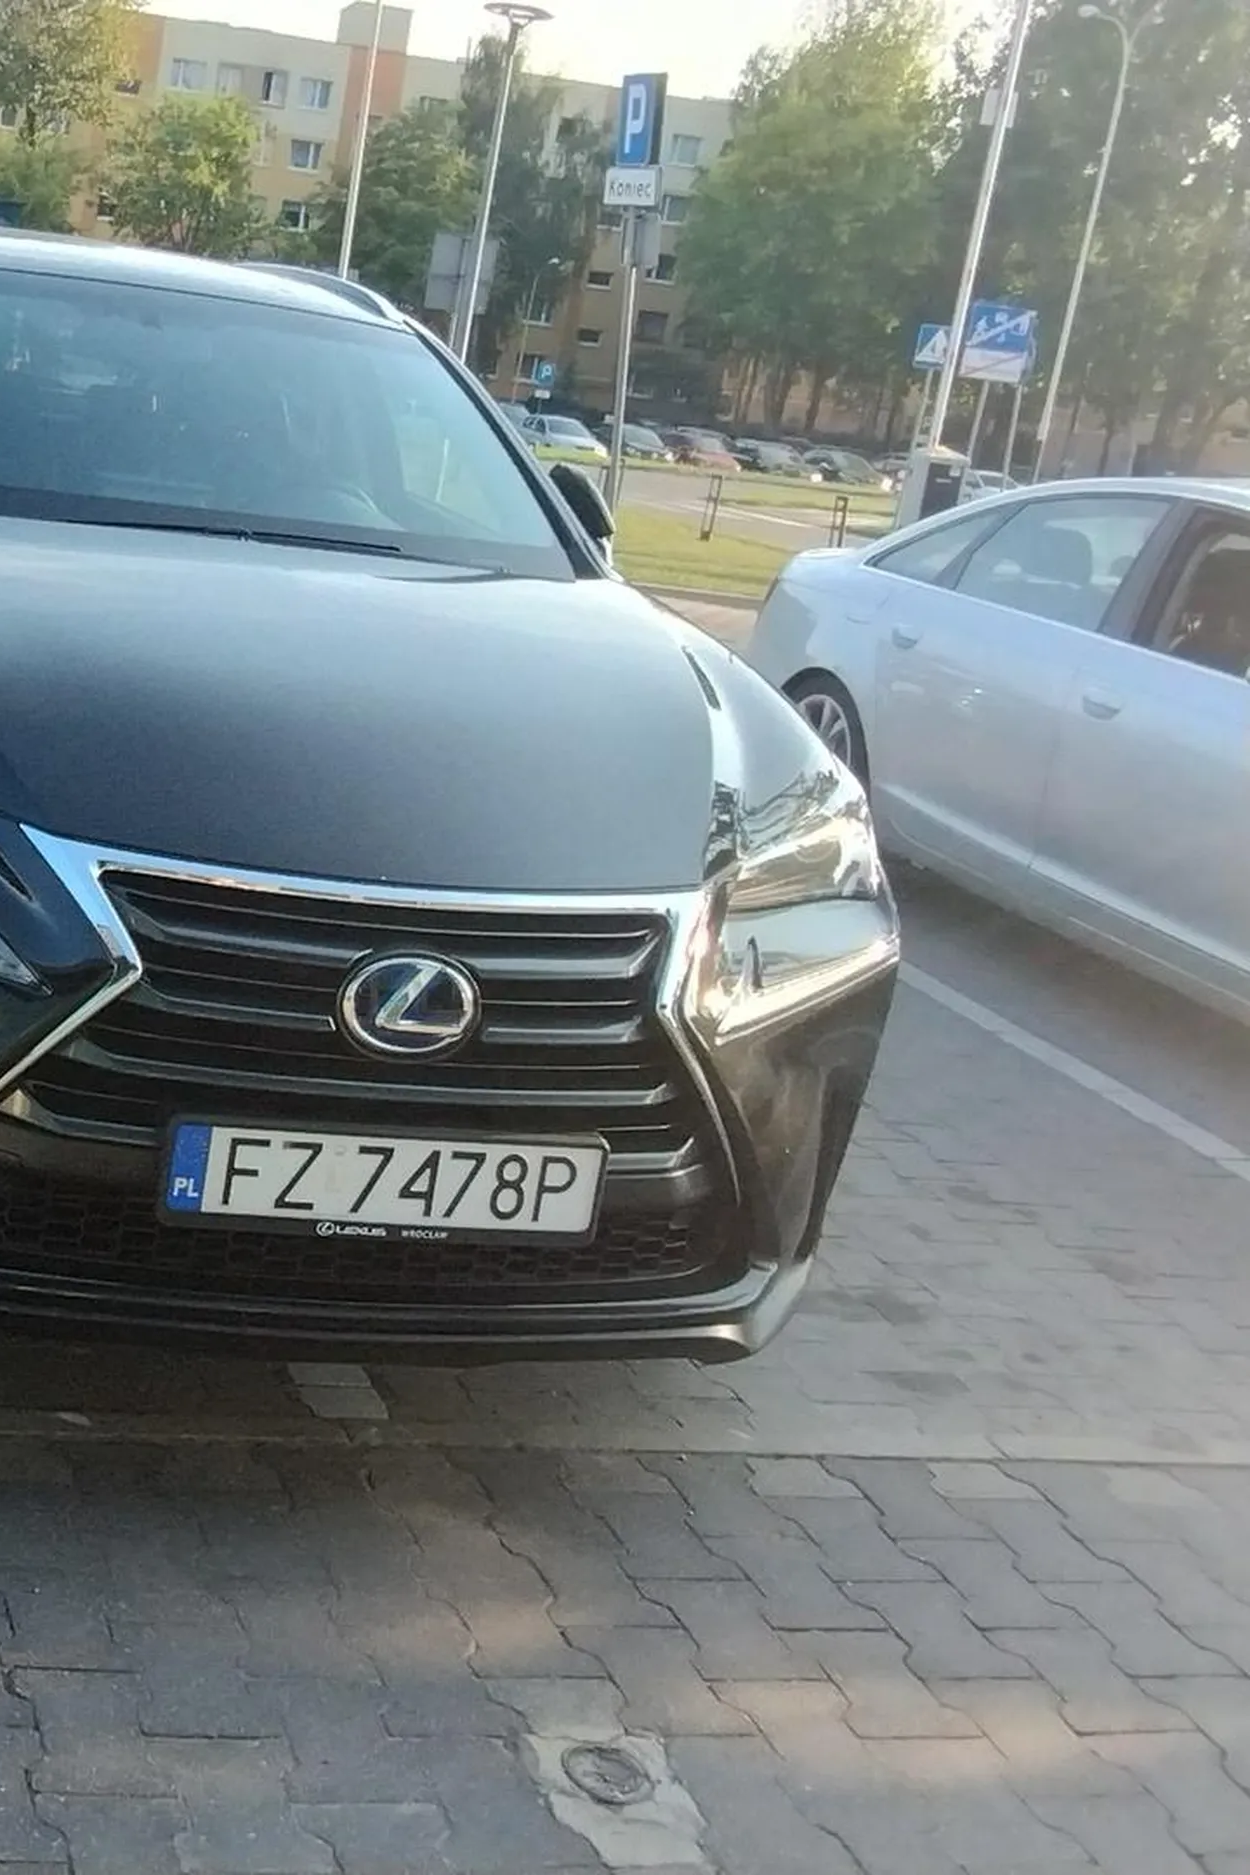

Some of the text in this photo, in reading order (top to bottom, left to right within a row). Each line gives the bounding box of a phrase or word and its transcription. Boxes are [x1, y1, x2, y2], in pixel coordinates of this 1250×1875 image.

[624, 83, 646, 154] P
[610, 180, 652, 198] Koniec
[173, 1176, 199, 1198] PL
[222, 1137, 578, 1223] FZ 7478P
[335, 1224, 387, 1237] LEXUS
